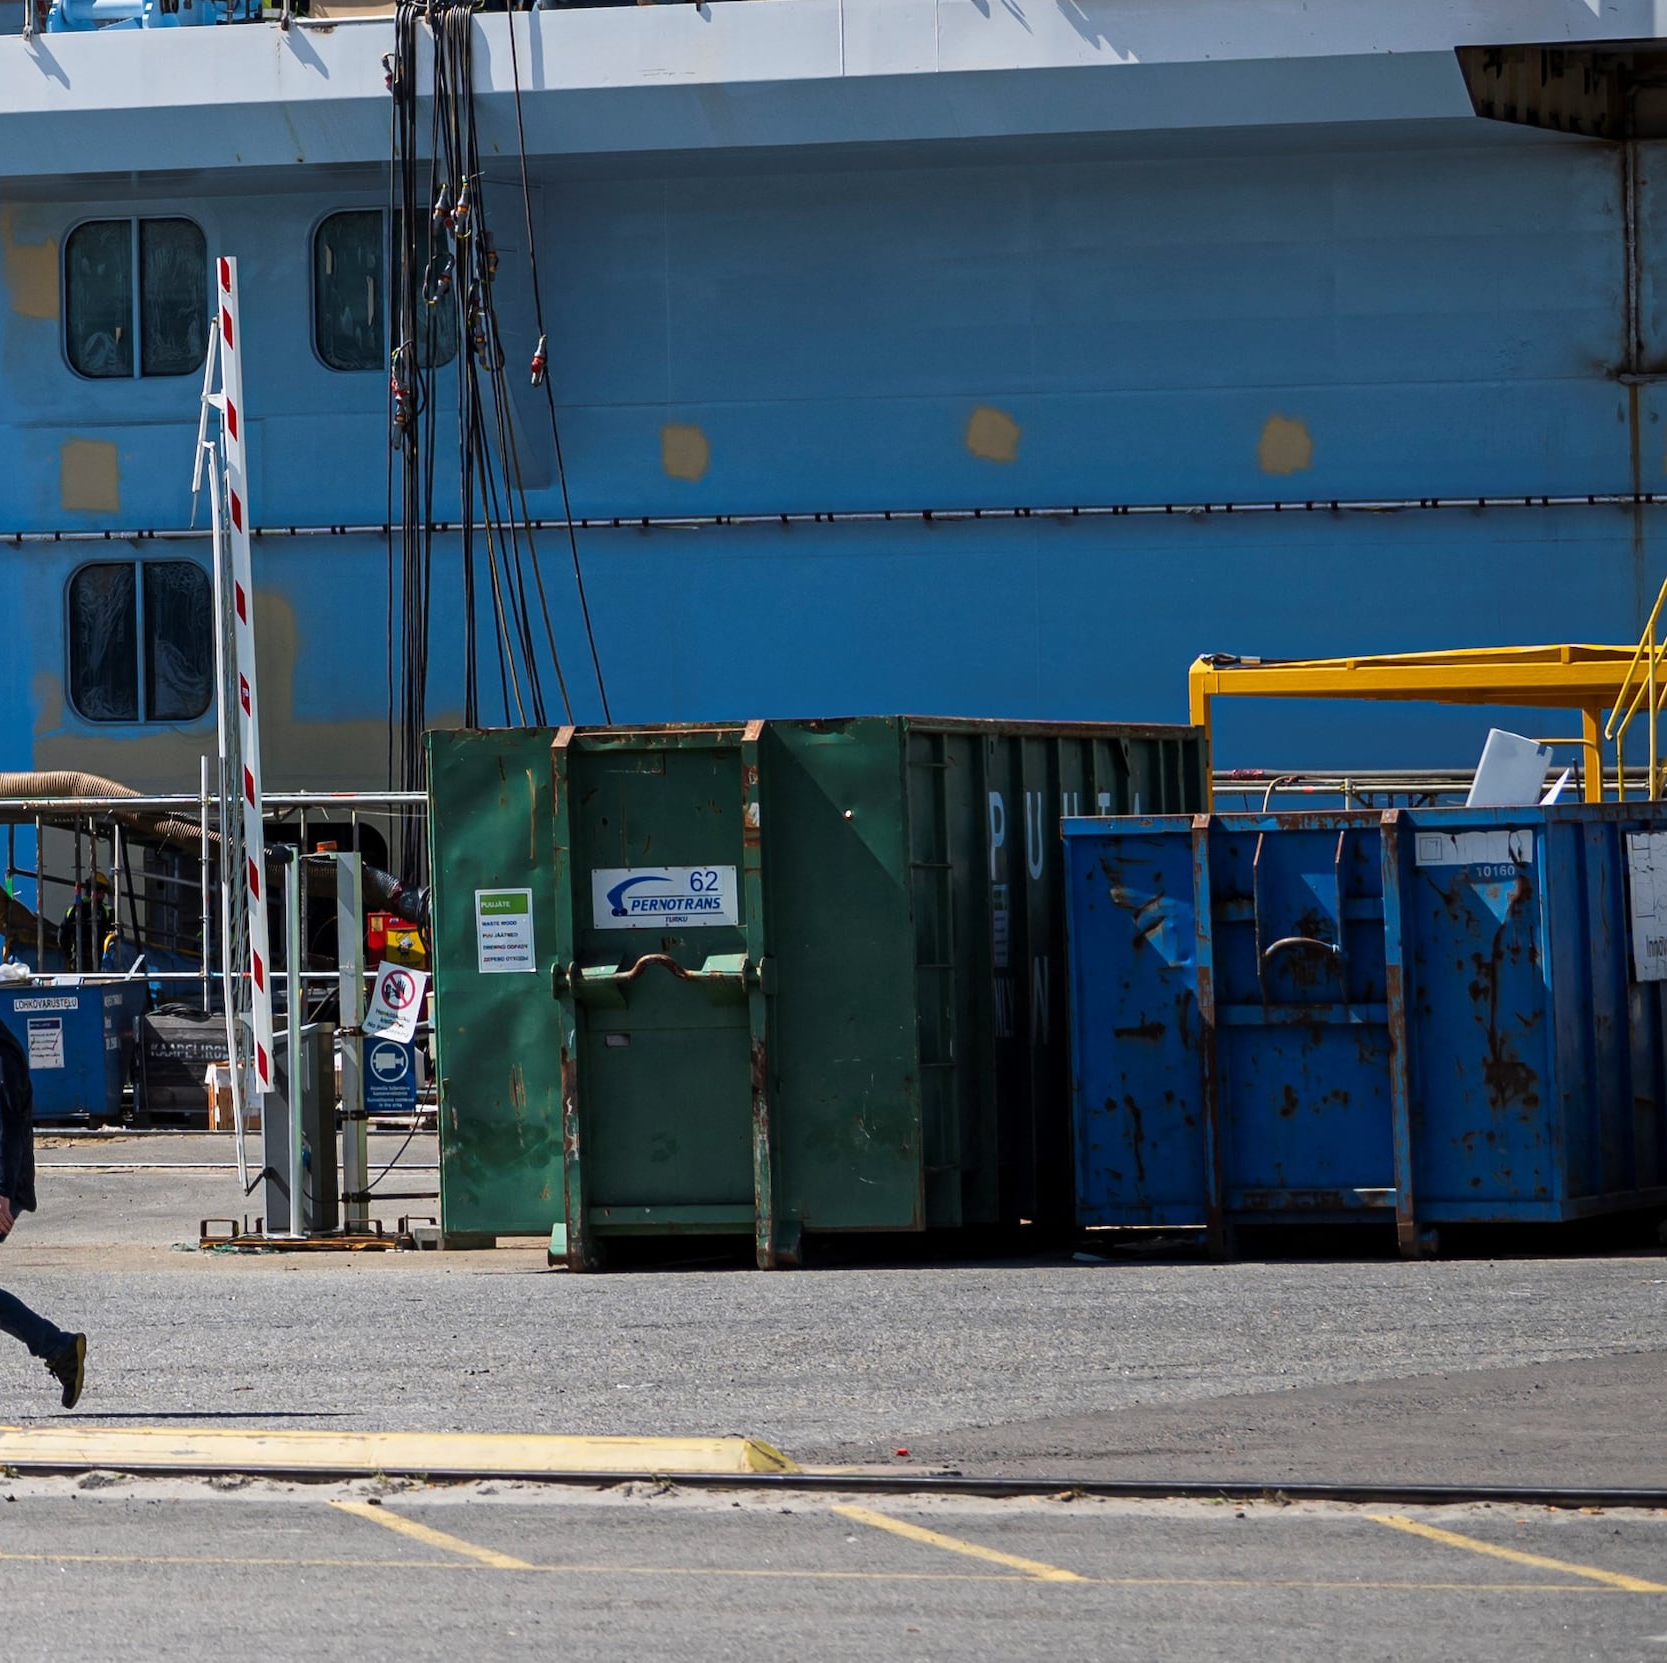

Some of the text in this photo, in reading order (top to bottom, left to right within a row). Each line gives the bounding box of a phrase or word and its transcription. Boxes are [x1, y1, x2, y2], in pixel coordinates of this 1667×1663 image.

[1476, 865, 1516, 877] 10160
[689, 871, 719, 892] 62
[631, 897, 721, 912] PERNOTRANS
[15, 997, 77, 1010] LOHKOVARUSTELU
